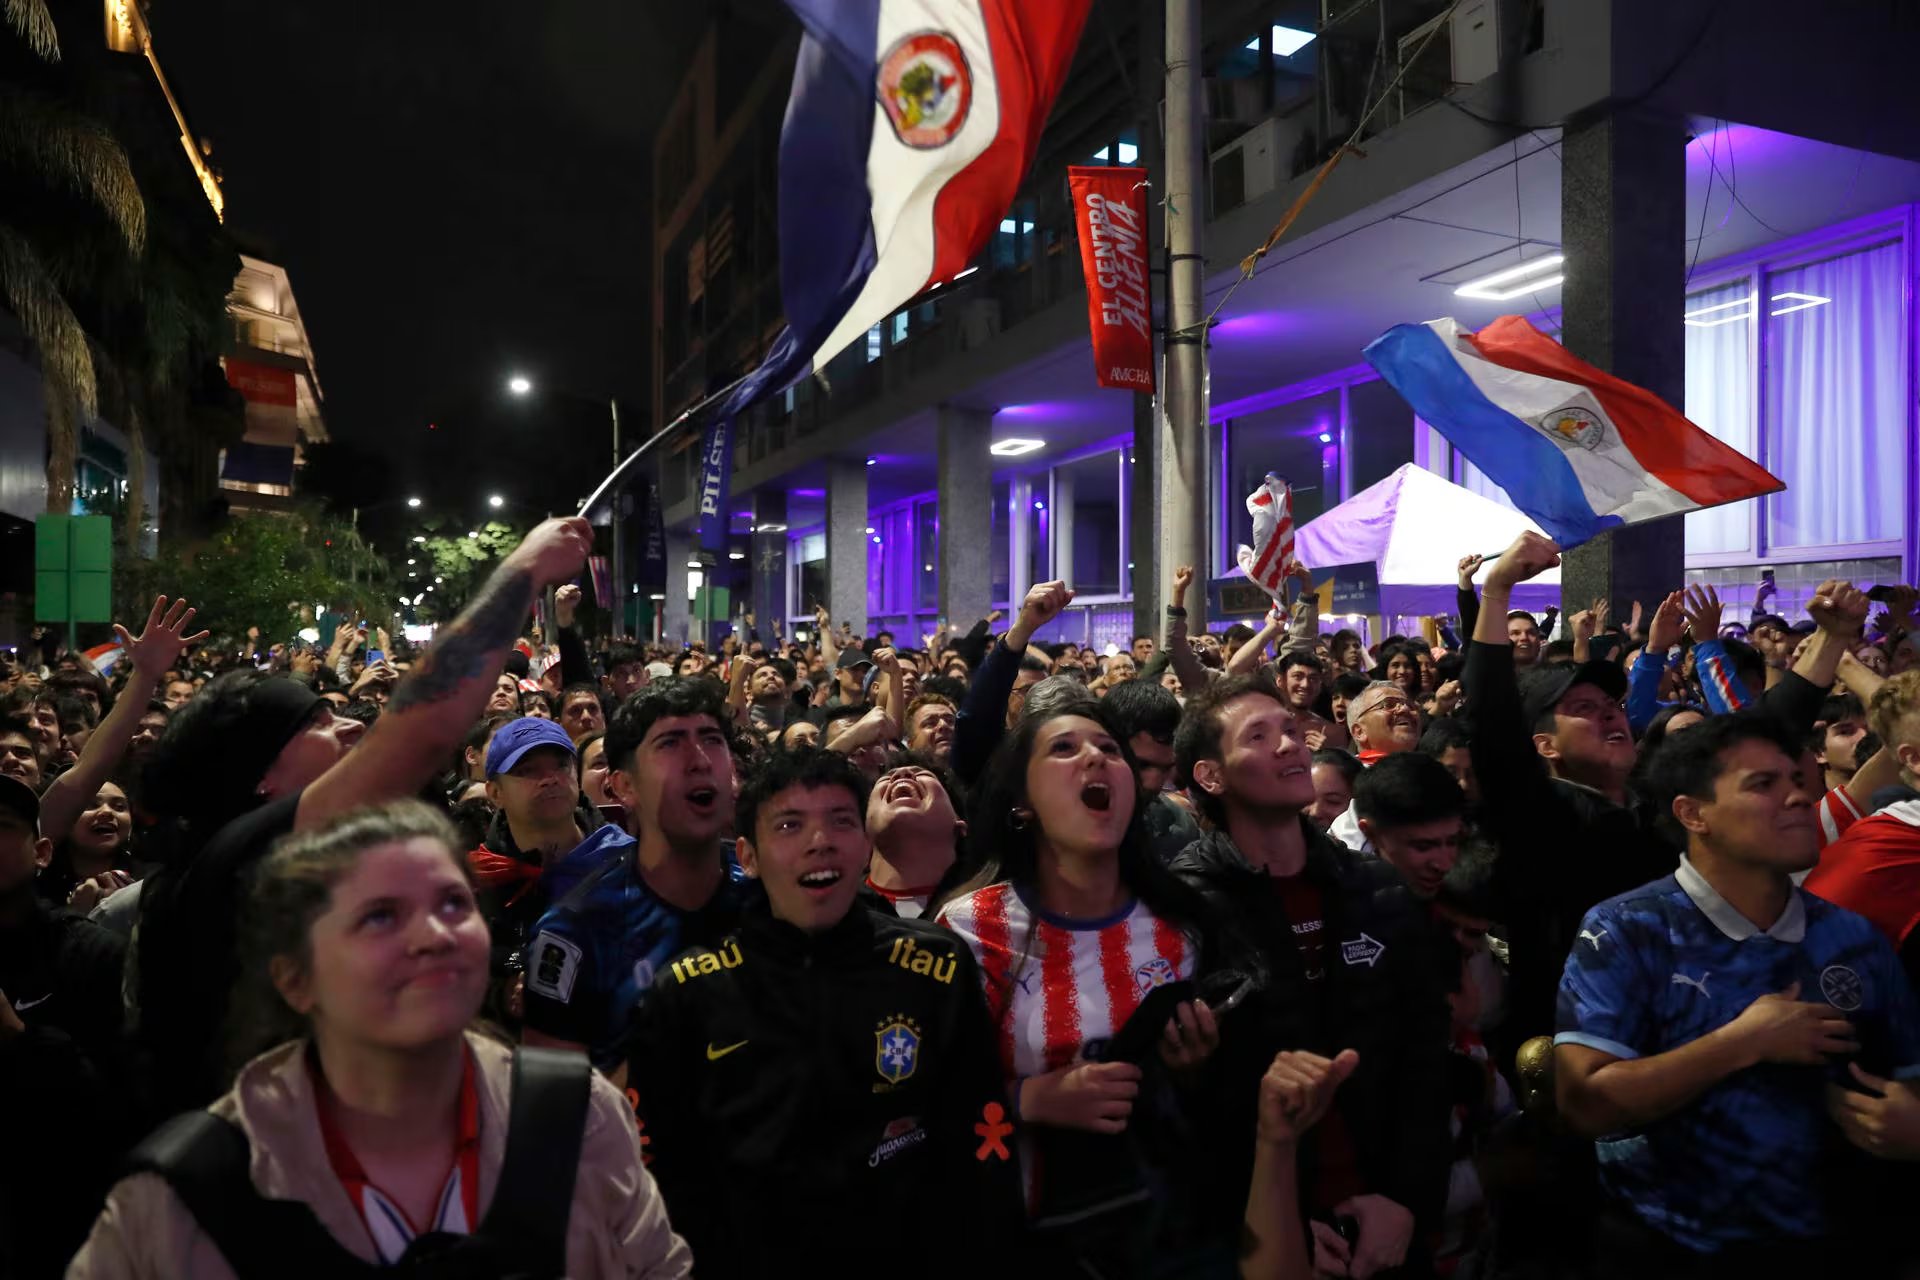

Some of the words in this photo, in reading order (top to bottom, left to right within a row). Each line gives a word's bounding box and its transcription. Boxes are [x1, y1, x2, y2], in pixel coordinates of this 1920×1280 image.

[1086, 193, 1121, 288] CENTRO
[1105, 200, 1149, 340] ALIENTA
[1102, 295, 1122, 326] EL
[1110, 367, 1150, 384] AMCHA
[671, 939, 744, 984] Itaú
[888, 938, 957, 984] Itaú
